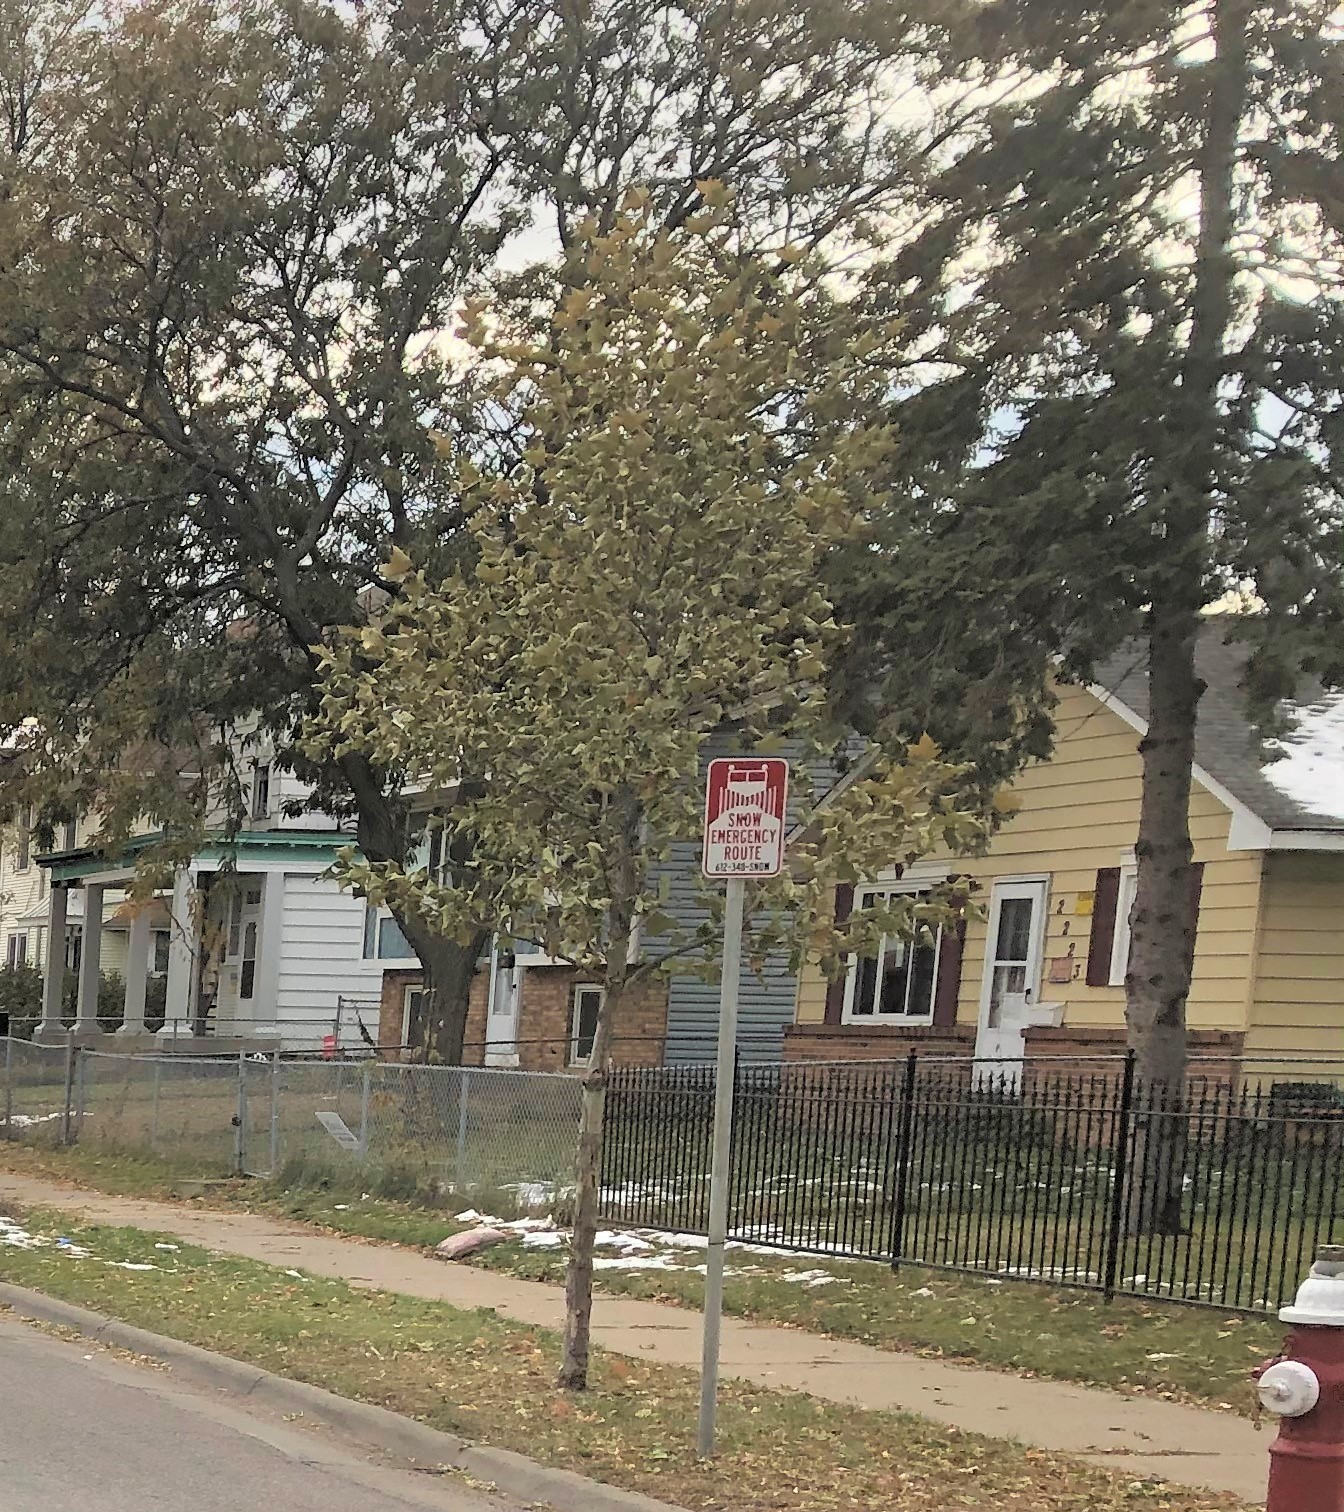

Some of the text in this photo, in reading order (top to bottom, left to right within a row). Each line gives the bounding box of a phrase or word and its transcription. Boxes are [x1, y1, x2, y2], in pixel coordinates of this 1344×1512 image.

[728, 812, 762, 827] SNOW
[711, 829, 776, 844] EMERGENCY
[724, 845, 761, 860] ROUTE
